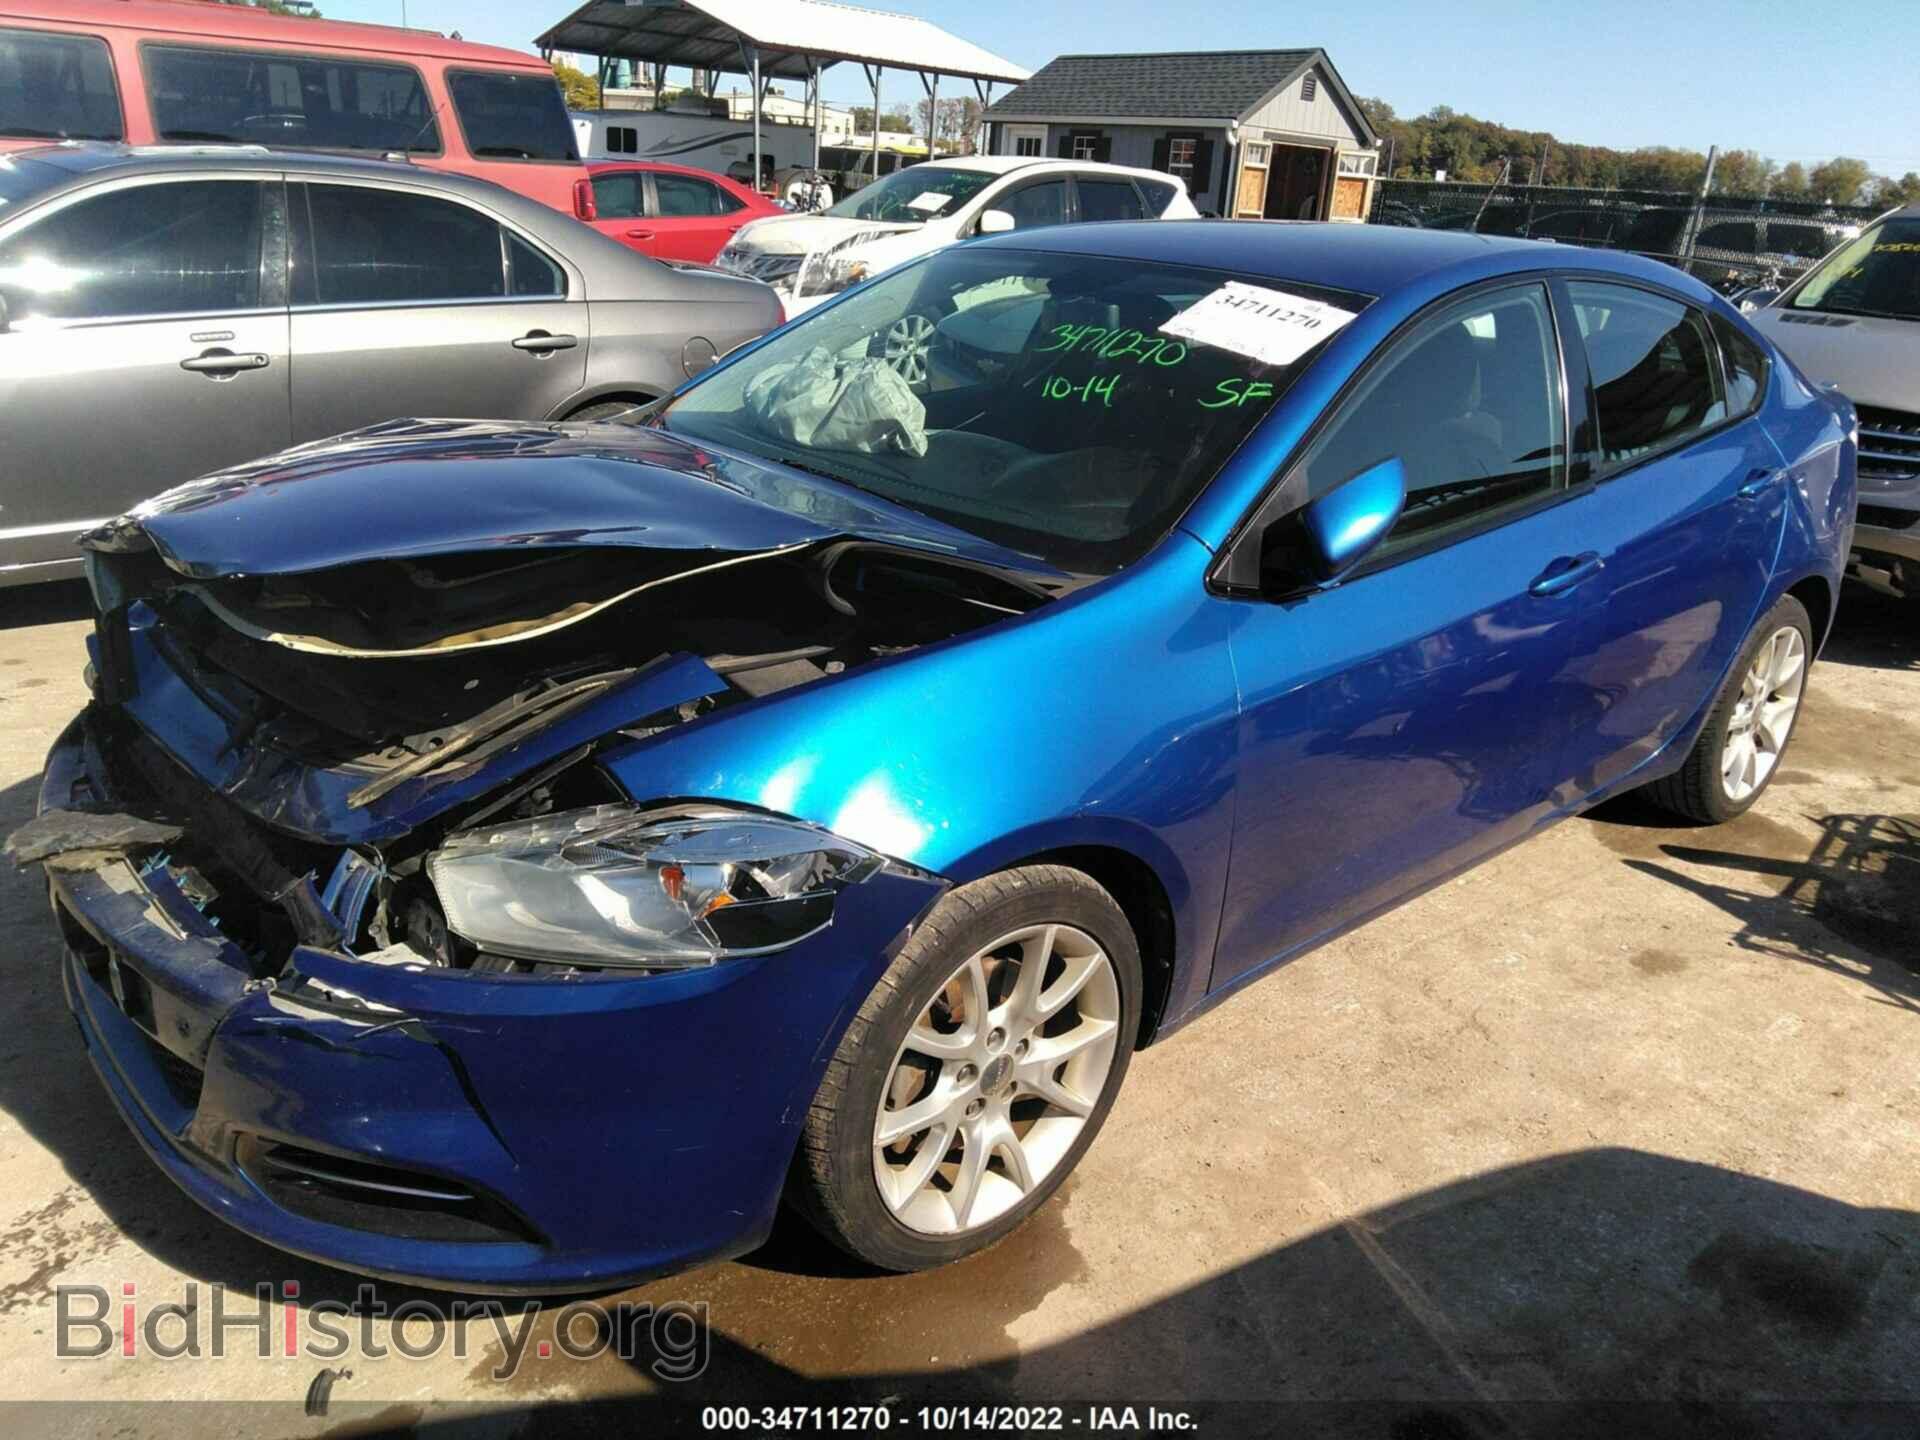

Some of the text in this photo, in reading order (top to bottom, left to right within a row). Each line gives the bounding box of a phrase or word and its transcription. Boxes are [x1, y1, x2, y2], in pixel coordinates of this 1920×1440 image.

[1216, 294, 1322, 330] 34711270
[1036, 323, 1187, 367] 34711270
[1041, 373, 1121, 408] 10-14
[1198, 377, 1274, 408] SF
